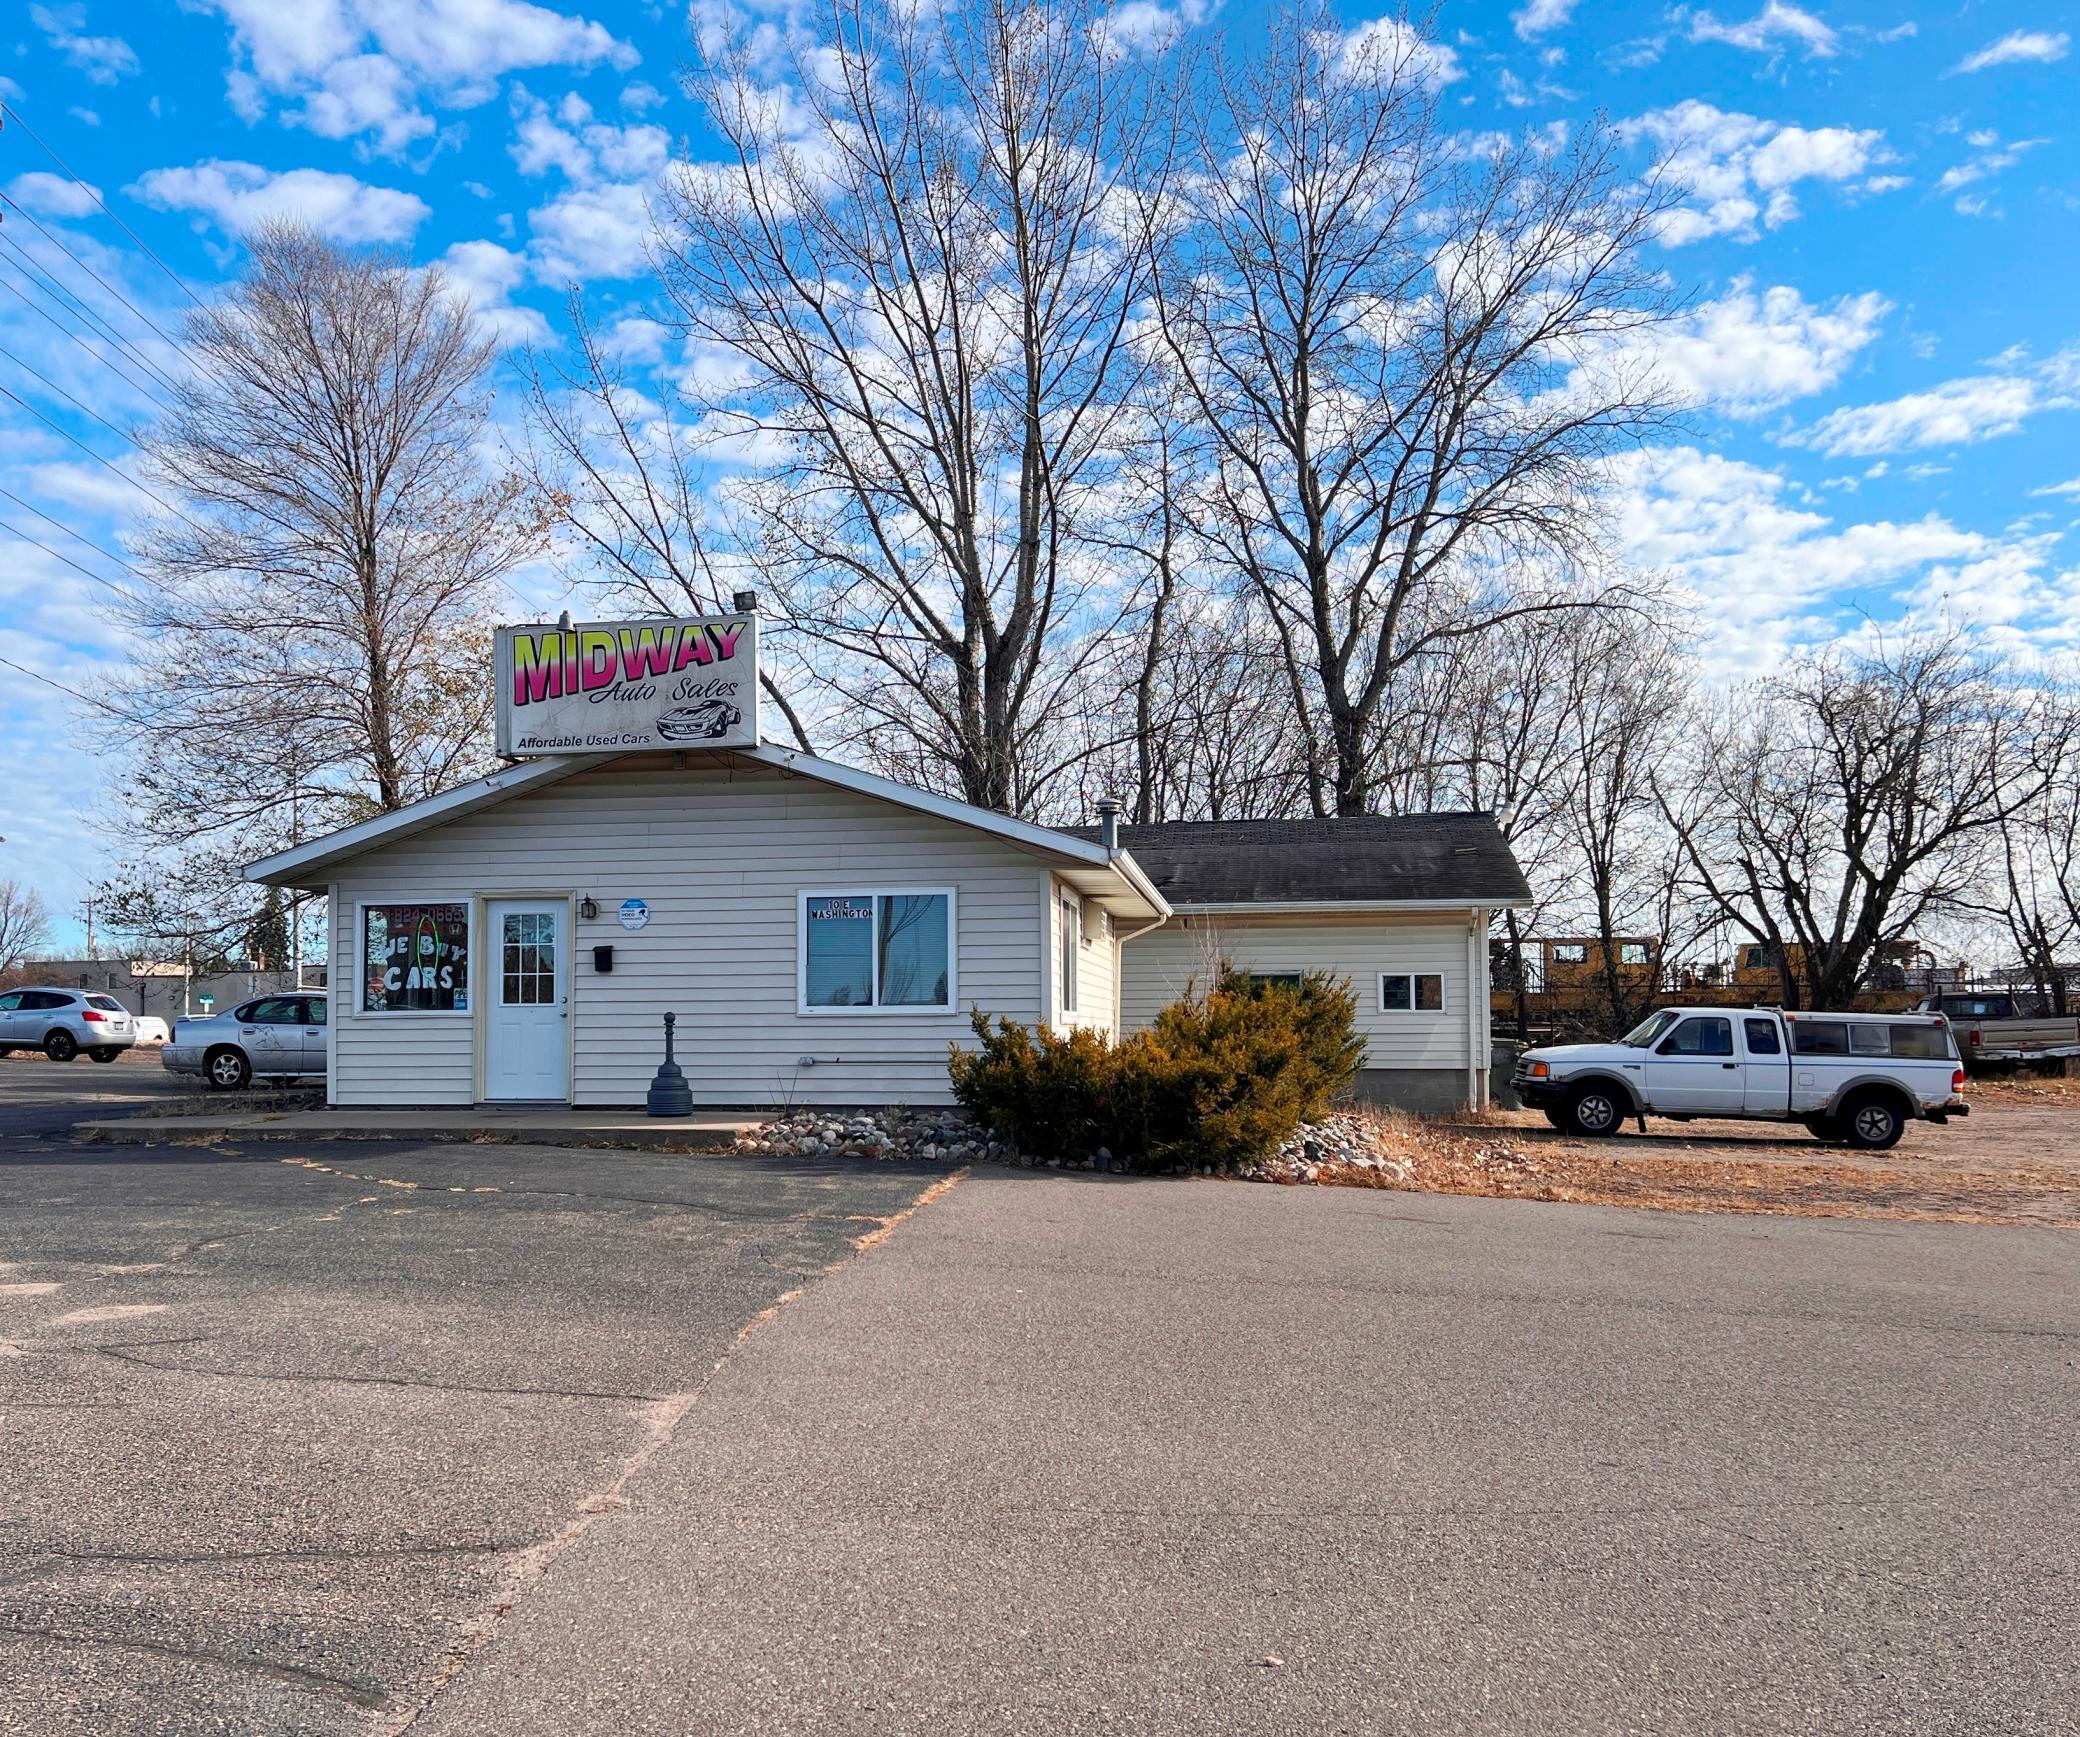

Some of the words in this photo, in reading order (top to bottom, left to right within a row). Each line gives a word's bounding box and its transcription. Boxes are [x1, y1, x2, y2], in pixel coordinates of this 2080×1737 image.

[513, 622, 747, 706] MIDWAY
[588, 680, 656, 704] Auto
[672, 677, 739, 701] Sales
[518, 735, 582, 749] Affordable
[586, 734, 618, 746] Used
[622, 733, 650, 744] Cars
[811, 909, 873, 919] WASHINGTON
[828, 900, 839, 909] 10
[843, 900, 849, 909] E
[383, 965, 454, 991] CARS
